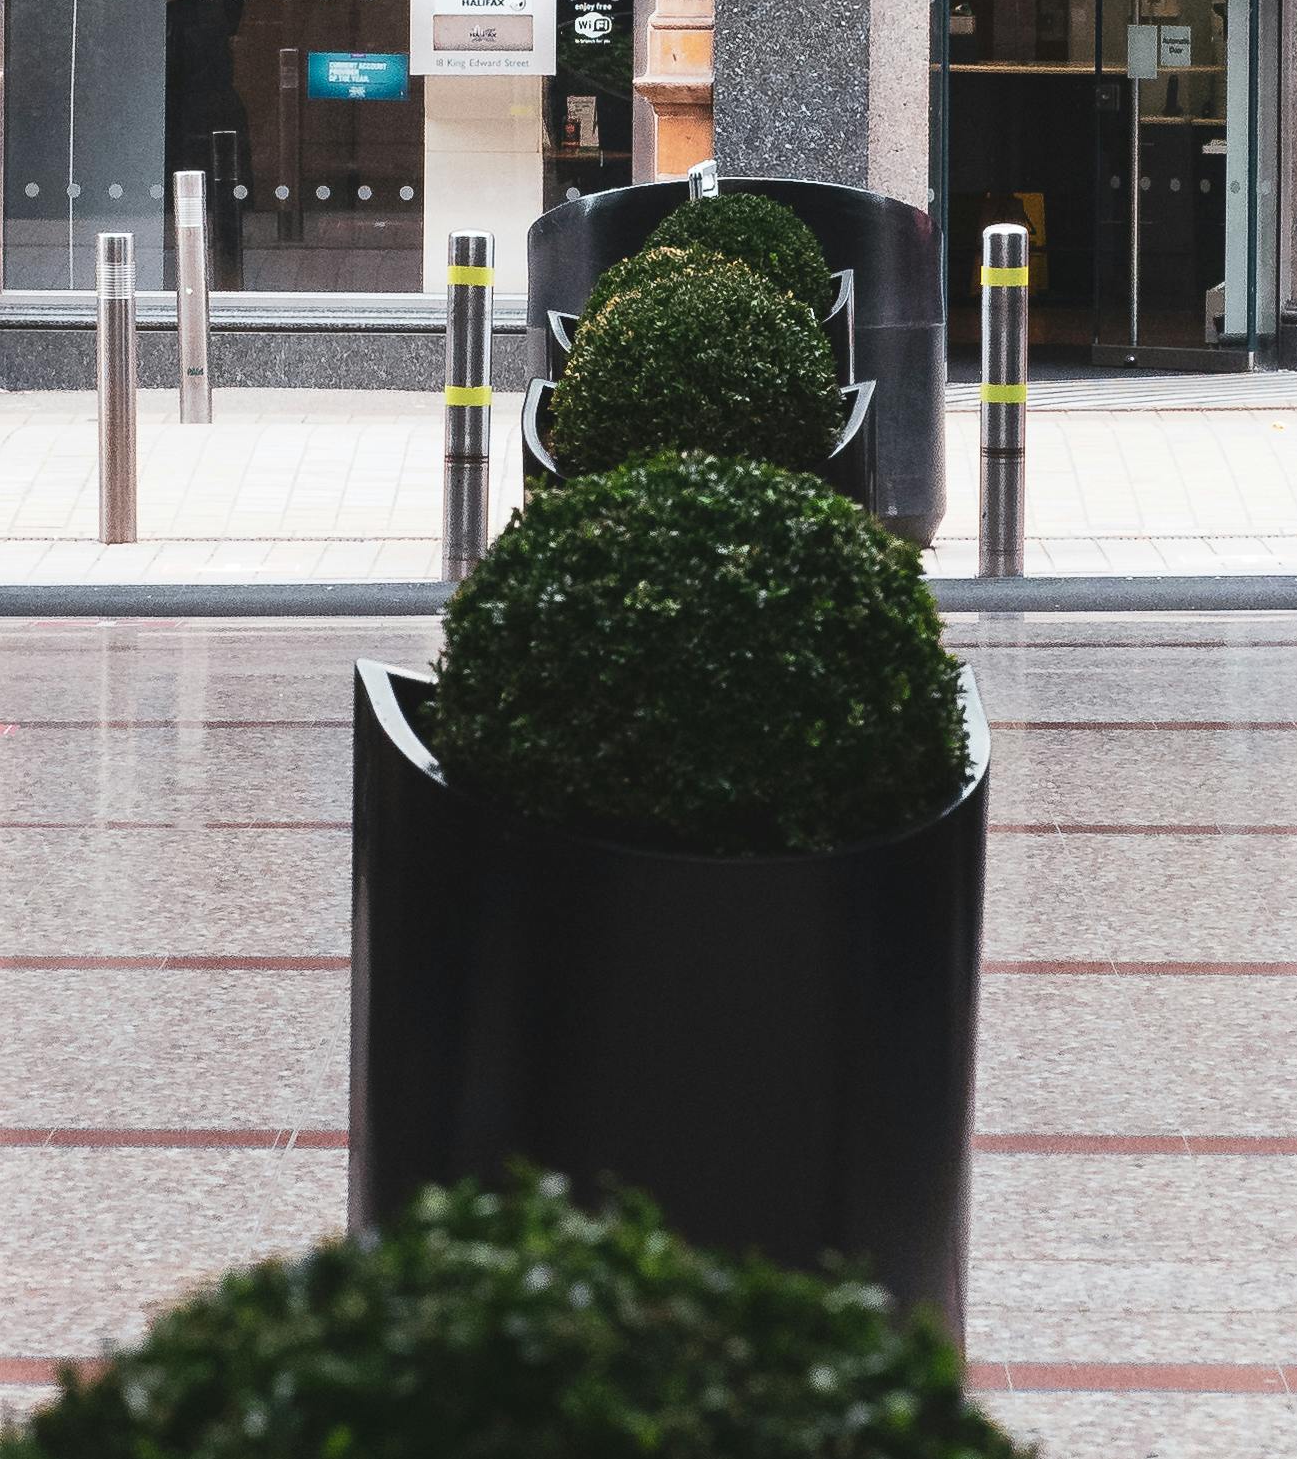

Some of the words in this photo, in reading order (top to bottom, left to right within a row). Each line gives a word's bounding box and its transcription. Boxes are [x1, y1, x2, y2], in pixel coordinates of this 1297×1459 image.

[575, 2, 595, 12] enjoy
[596, 2, 613, 11] free
[436, 58, 444, 67] 18
[447, 58, 466, 69] King
[469, 58, 501, 67] Edward
[504, 58, 530, 67] Street
